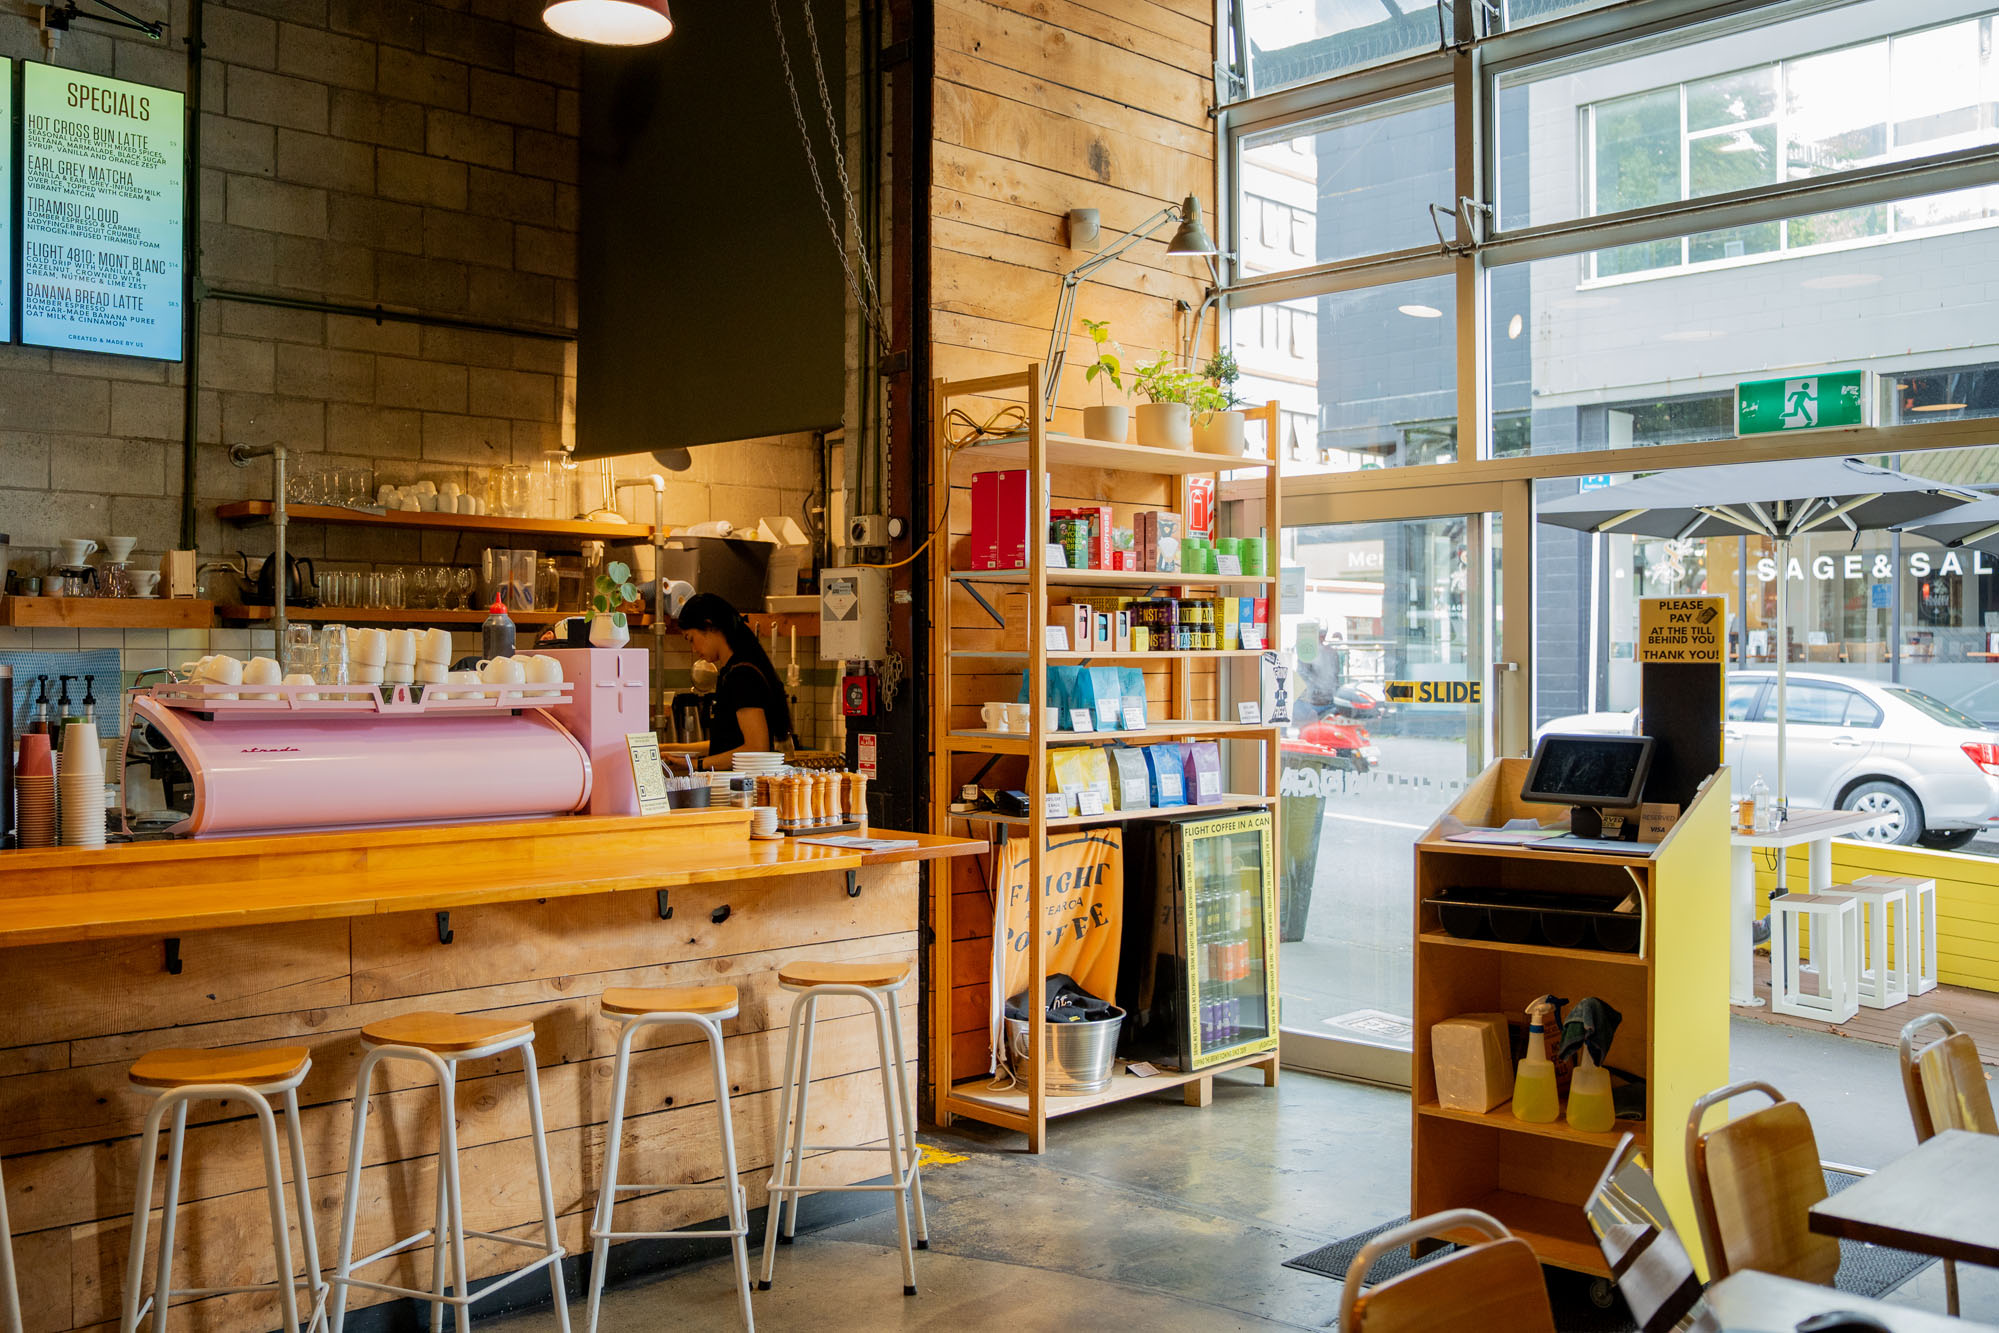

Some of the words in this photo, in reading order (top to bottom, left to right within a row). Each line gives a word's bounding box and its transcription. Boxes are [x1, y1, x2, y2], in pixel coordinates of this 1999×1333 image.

[68, 83, 150, 121] SPECIALS
[28, 114, 50, 130] HOT
[54, 119, 90, 138] CROSS
[93, 126, 115, 143] BUN
[118, 131, 148, 149] LATTE
[28, 129, 67, 140] SEASONAL
[70, 136, 91, 145] LATTE
[115, 144, 136, 153] MIXED
[57, 147, 88, 157] VANILLA
[90, 152, 106, 160] AND
[109, 156, 140, 166] ORANGE
[118, 151, 141, 159] BLACK
[143, 156, 166, 165] SUGAR
[28, 155, 54, 172] EARL
[58, 161, 85, 177] GREY
[89, 166, 133, 186] MATCHA
[28, 170, 60, 180] VANILLA
[90, 180, 142, 193] GREY-INFUSED
[144, 188, 161, 196] MILK
[28, 182, 61, 193] VIBRANT
[64, 188, 95, 198] MATCHA
[67, 182, 96, 192] TOPPED
[119, 190, 144, 200] CREAM
[28, 196, 80, 218] TIRAMISU
[85, 206, 118, 224] CLOUD
[28, 211, 59, 221] BOMBER
[62, 215, 98, 226] ESPRESSO
[107, 224, 141, 233] CARAMEL
[28, 218, 74, 229] LADYFINGER
[77, 225, 105, 234] BISCUIT
[107, 229, 140, 239] CRUMBLE
[28, 224, 101, 239] NITROGEN-INFUSED
[104, 236, 137, 245] TIRAMISU
[27, 241, 63, 259] FLIGHT
[67, 248, 95, 264] 4810:
[99, 252, 129, 269] MONT
[133, 257, 165, 274] BLANC
[62, 274, 96, 283] NUTMEG
[76, 270, 118, 280] CROWNED
[98, 266, 133, 276] VANILLA
[27, 282, 71, 302] BANANA
[76, 289, 109, 306] BREAD
[113, 294, 143, 311] LATTE
[27, 297, 62, 306] BOMBER
[65, 302, 105, 312] ESPRESSO
[27, 304, 89, 317] HANGAR-MADE
[93, 312, 127, 321] BANANA
[78, 317, 124, 327] CINNAMON
[1660, 601, 1703, 610] PLEASE
[1670, 614, 1692, 623] PAY
[1643, 651, 1684, 659] THANK
[1689, 651, 1718, 659] YOU!
[1419, 682, 1481, 703] SLIDE
[1184, 826, 1209, 836] FLIGHT
[1211, 822, 1236, 833] COFFEE
[1255, 818, 1270, 827] CAN
